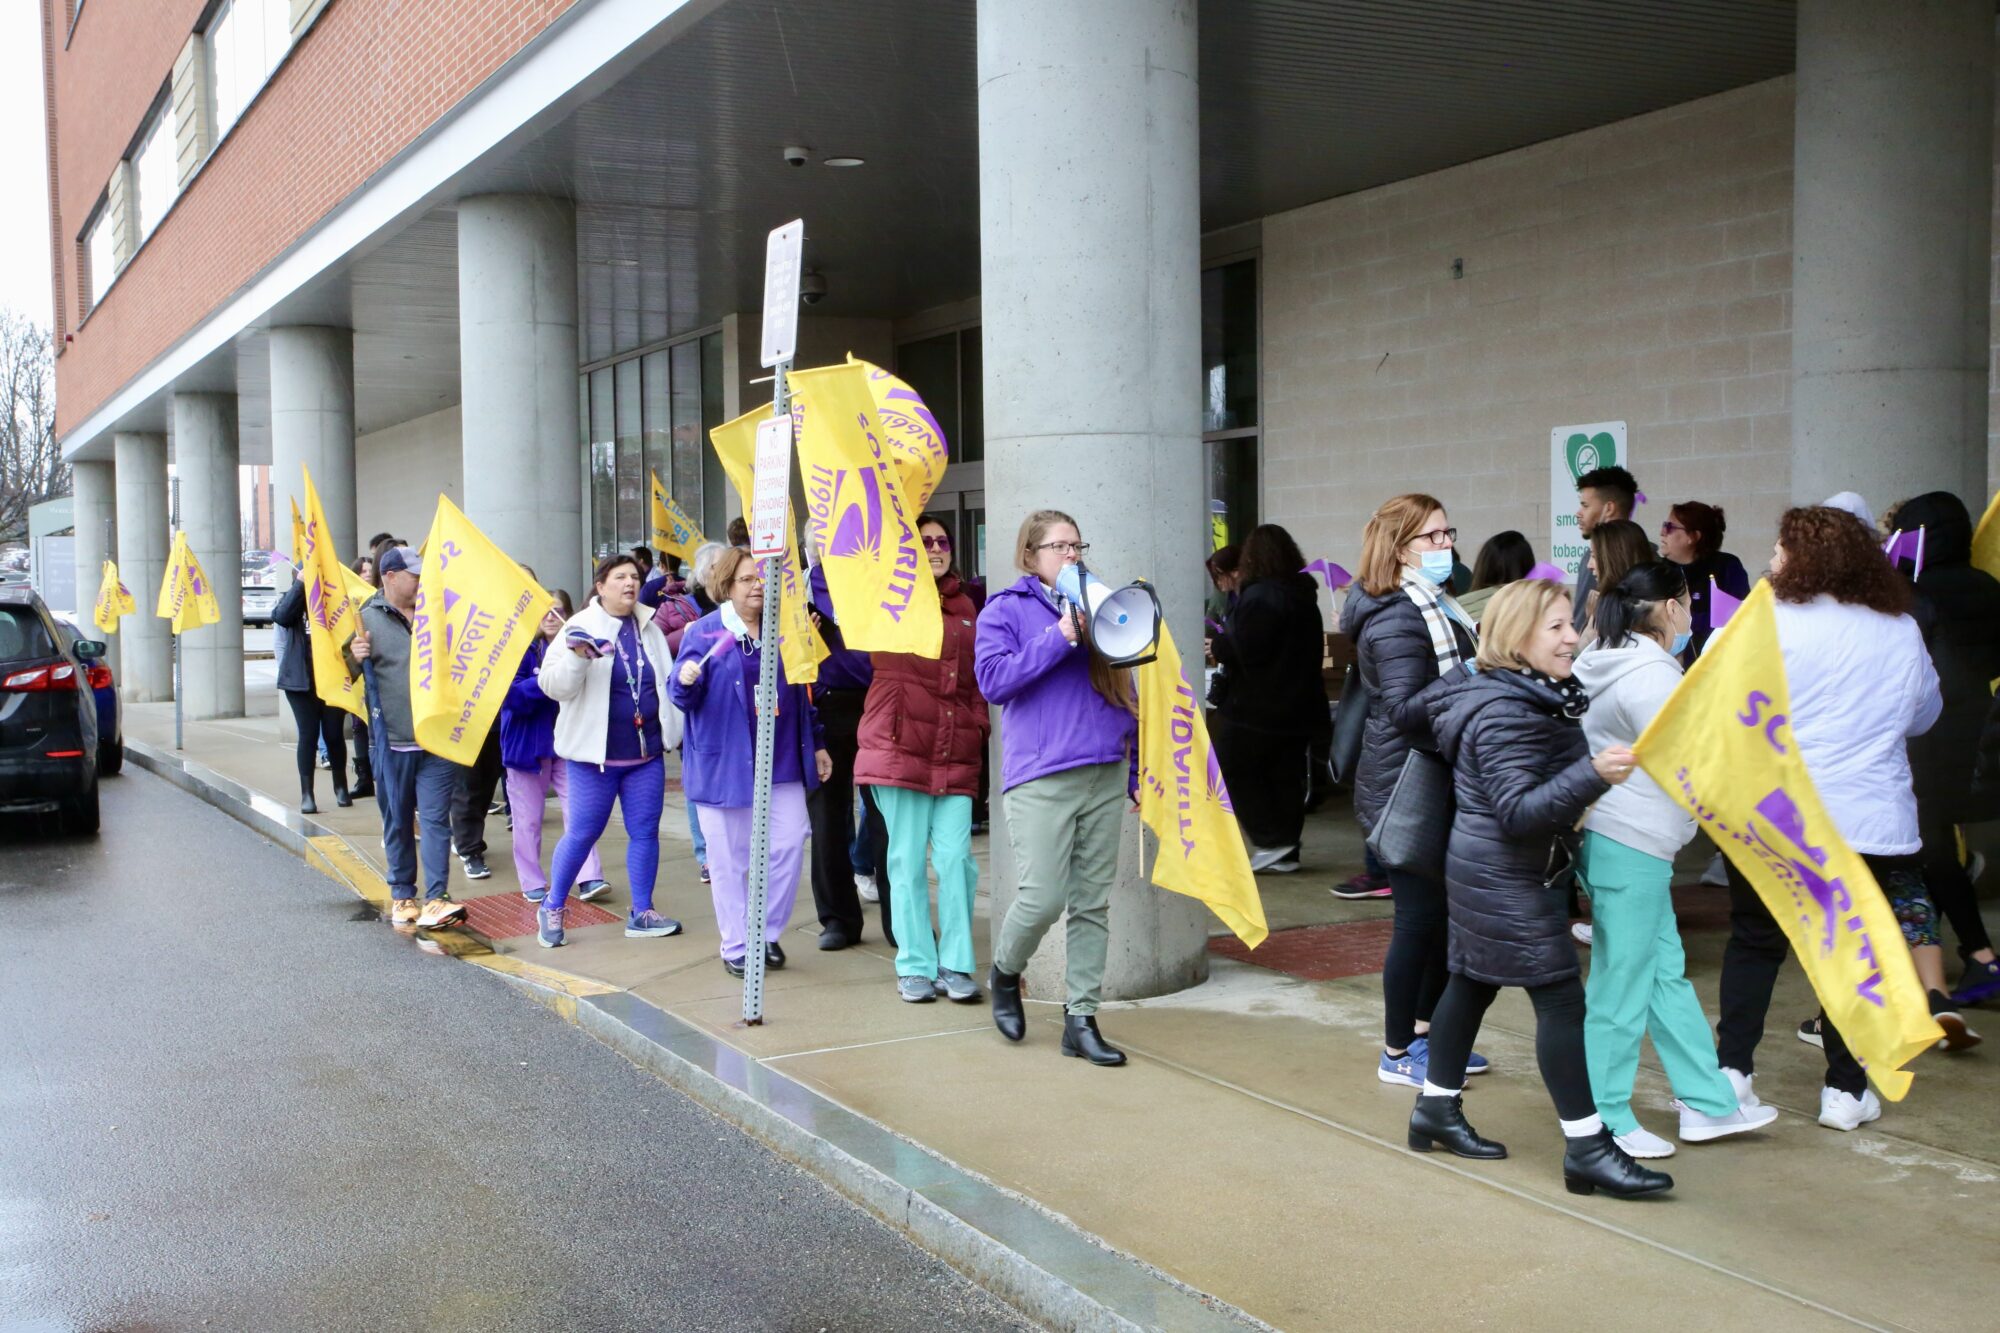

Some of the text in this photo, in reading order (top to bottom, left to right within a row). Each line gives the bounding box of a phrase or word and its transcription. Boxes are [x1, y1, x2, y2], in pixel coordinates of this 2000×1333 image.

[759, 453, 786, 471] PARKING
[758, 475, 785, 492] STOPPING
[757, 496, 784, 512] STANDING
[756, 515, 782, 533] ANY TIME
